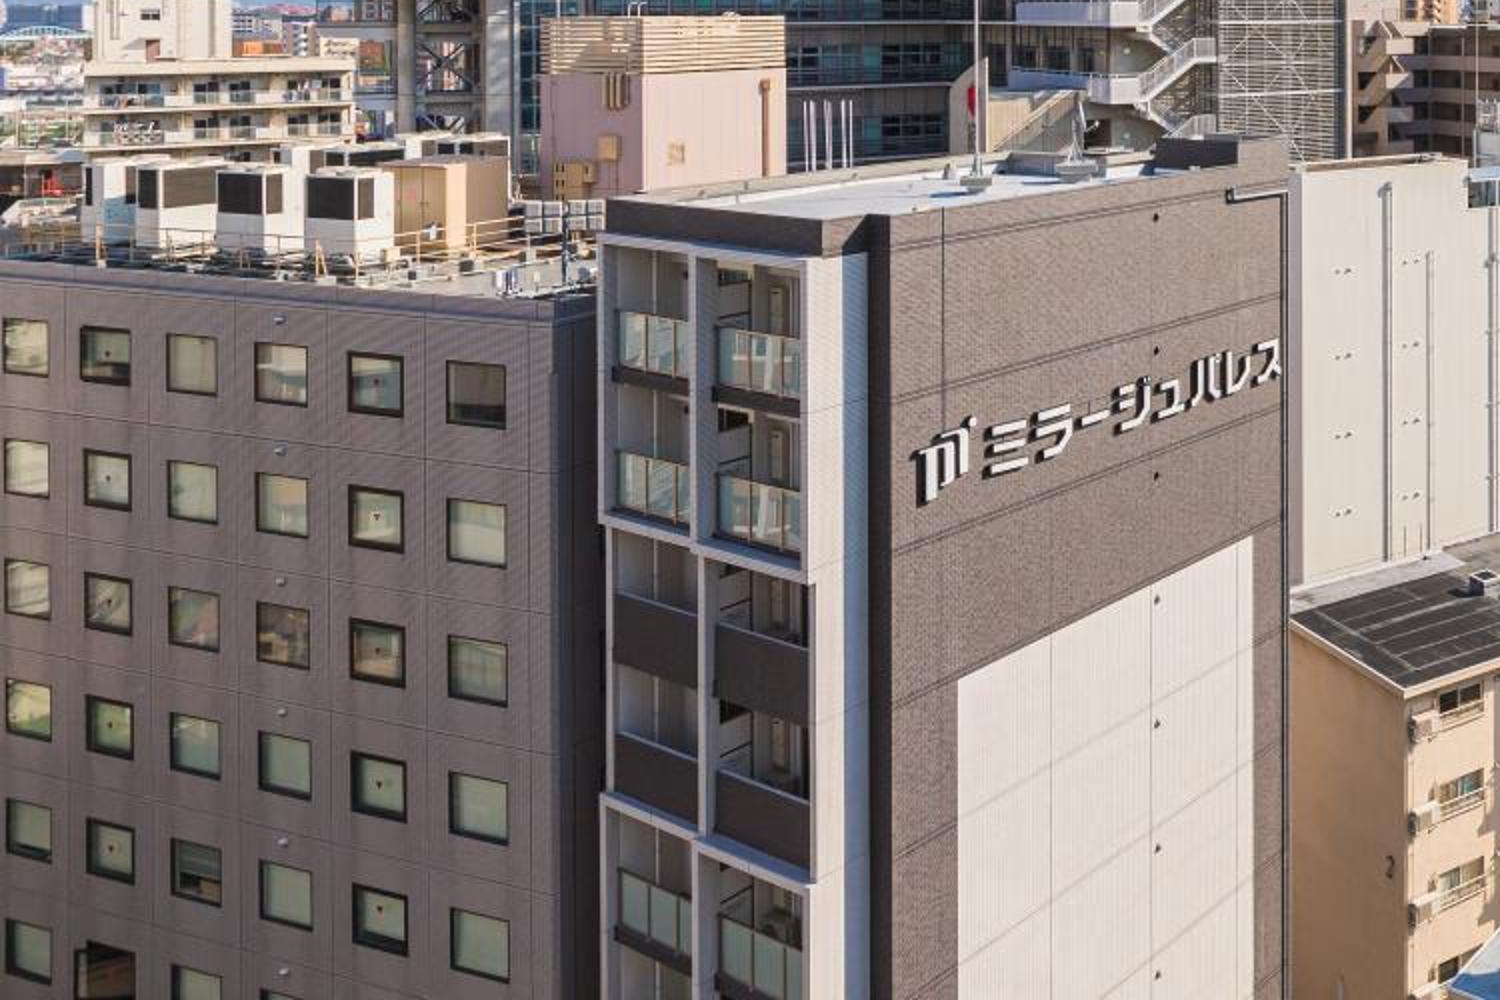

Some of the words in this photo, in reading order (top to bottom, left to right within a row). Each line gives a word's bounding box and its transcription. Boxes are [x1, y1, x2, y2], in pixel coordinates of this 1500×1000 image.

[988, 337, 1281, 476] ミラージュパレス
